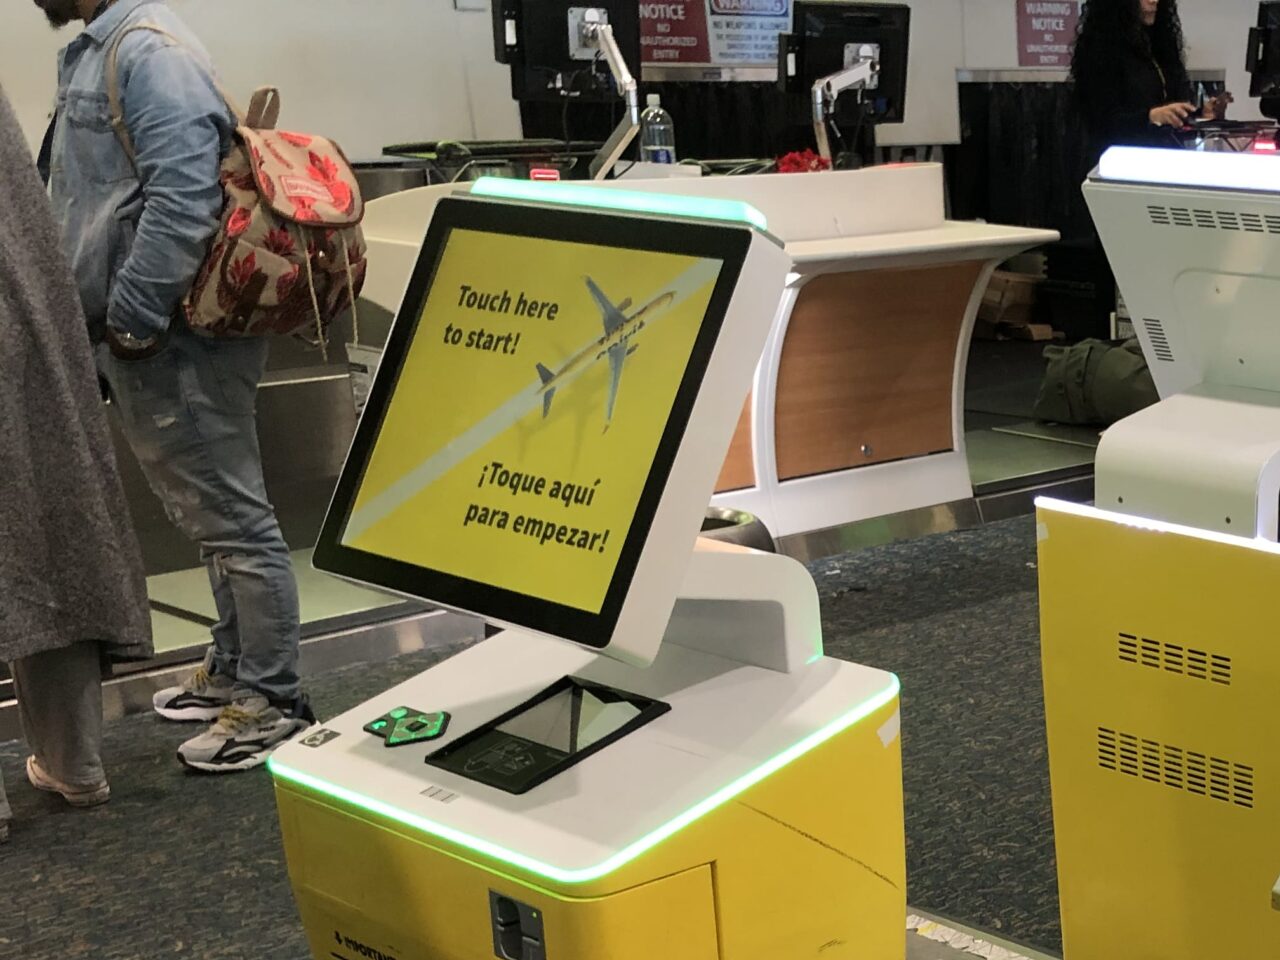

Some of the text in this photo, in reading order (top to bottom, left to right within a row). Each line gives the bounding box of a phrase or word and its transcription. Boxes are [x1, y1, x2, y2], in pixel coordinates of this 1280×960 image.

[639, 4, 686, 20] NOTICE
[656, 23, 671, 33] NO
[1031, 17, 1066, 31] NOTICE
[640, 36, 698, 47] NAUTHORIZED
[652, 49, 680, 59] ENTRY
[457, 285, 559, 321] Touch here
[443, 323, 520, 355] to start!
[477, 461, 601, 509] ¡Toque aquí
[463, 503, 611, 554] para empezar!
